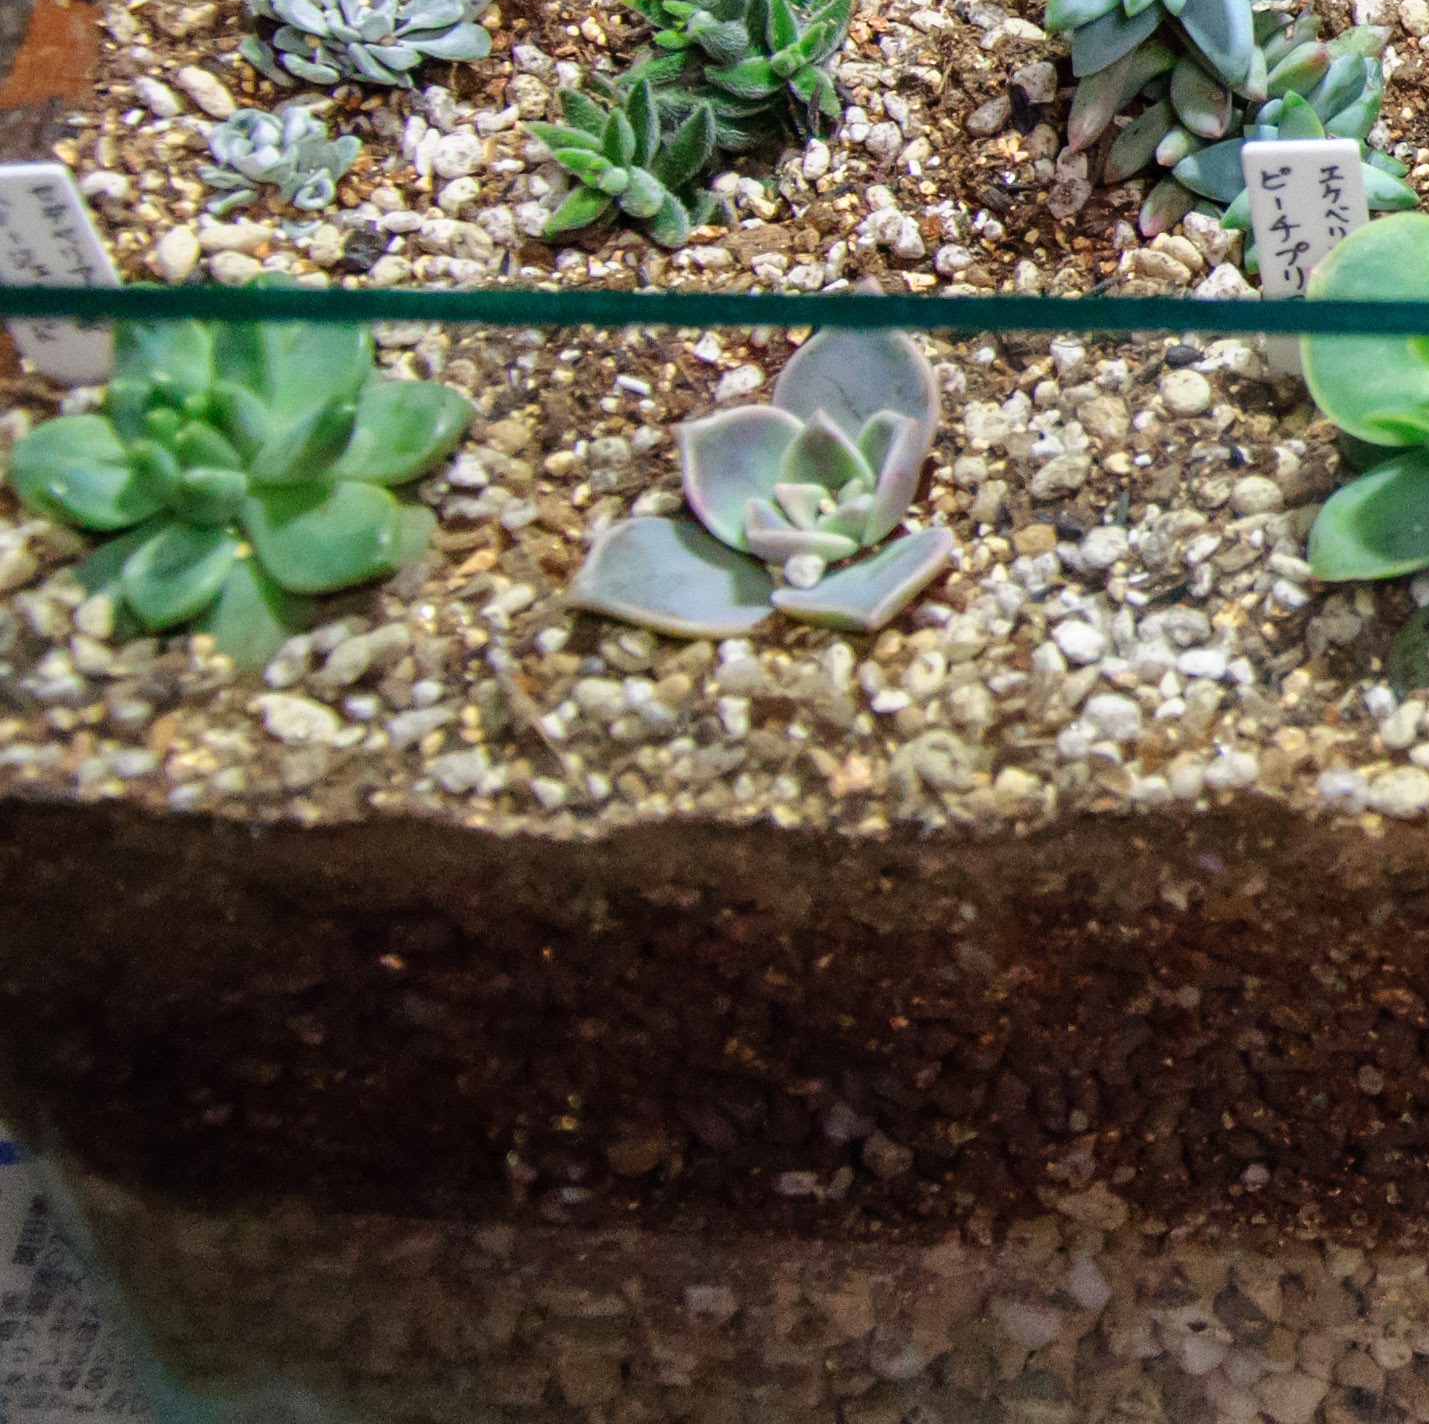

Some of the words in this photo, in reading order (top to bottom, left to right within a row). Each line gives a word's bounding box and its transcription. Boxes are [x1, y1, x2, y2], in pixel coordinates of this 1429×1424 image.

[1260, 165, 1312, 300] ピーチプリ
[1318, 164, 1351, 250] エケベリ
